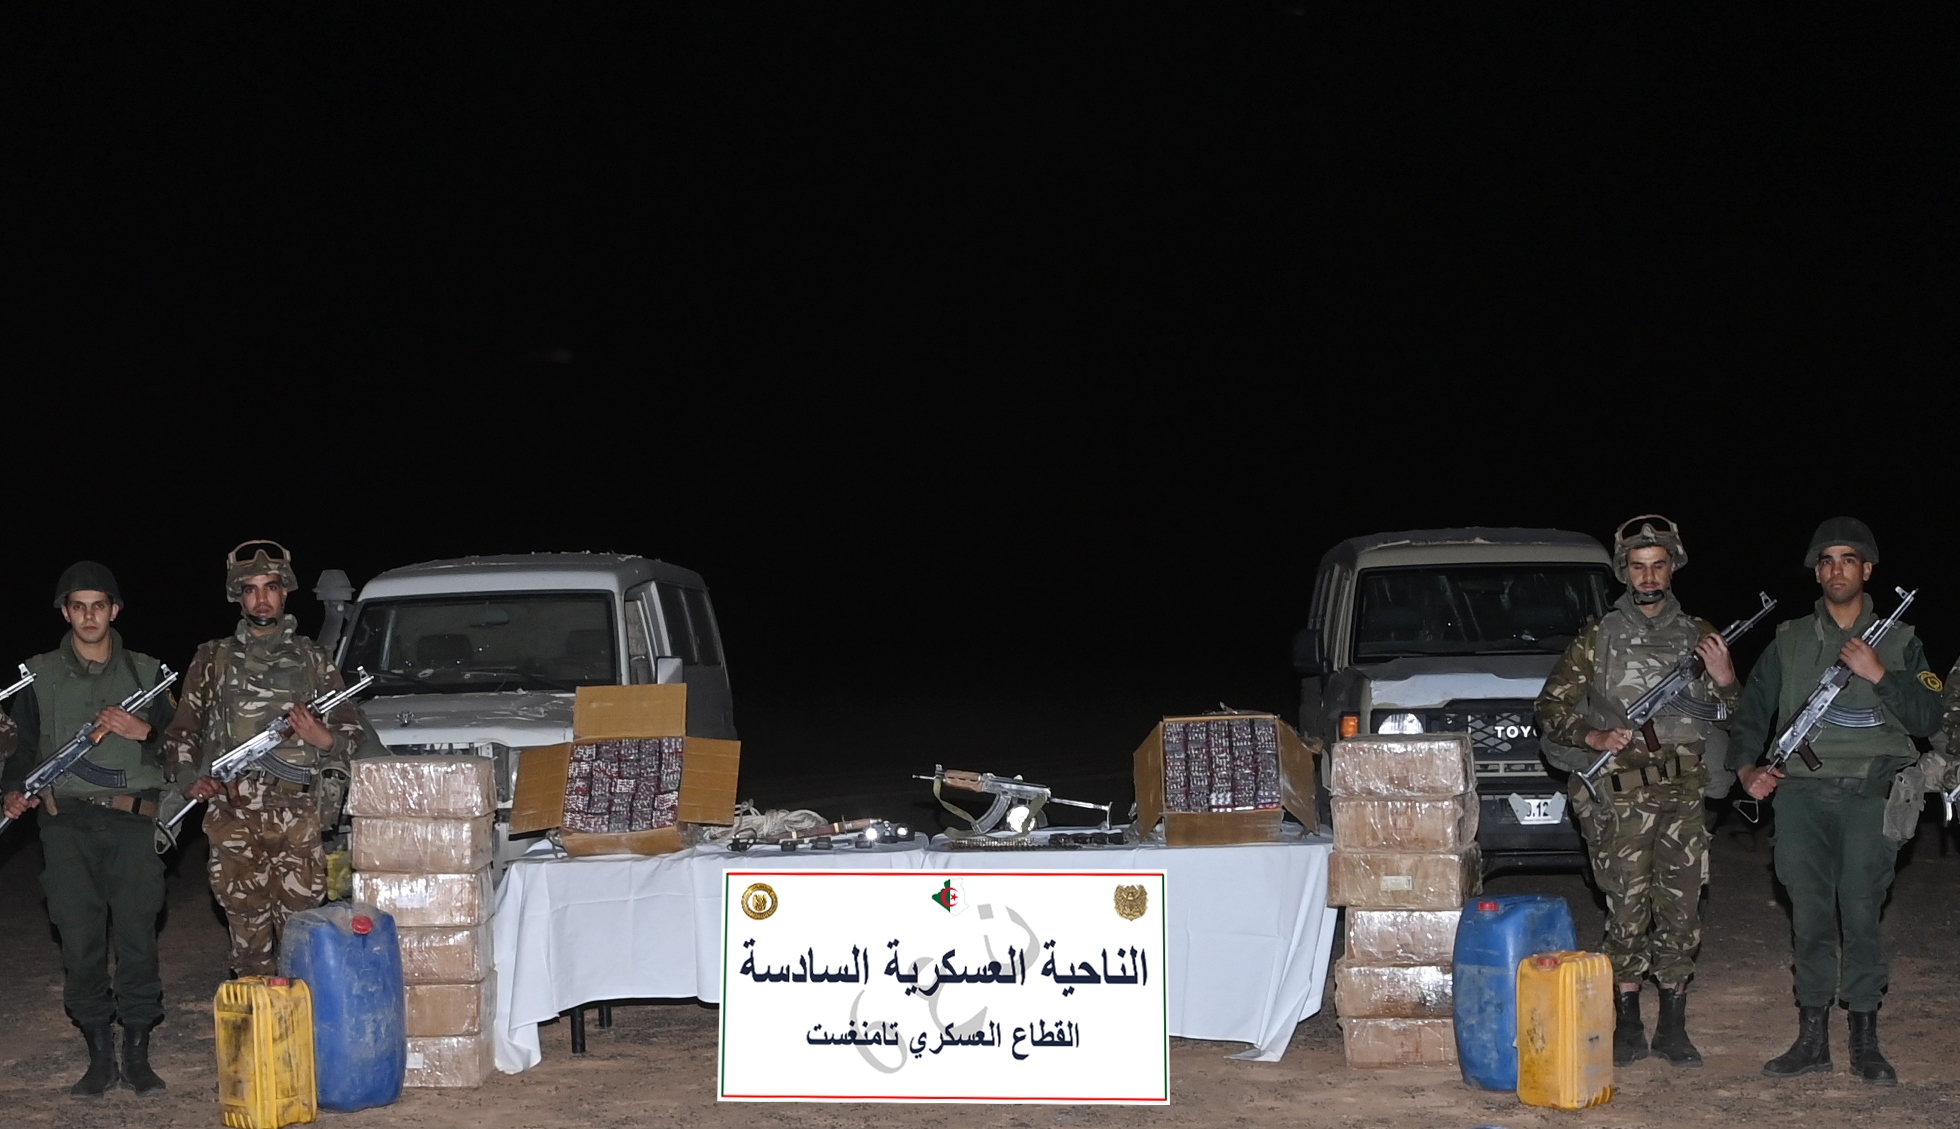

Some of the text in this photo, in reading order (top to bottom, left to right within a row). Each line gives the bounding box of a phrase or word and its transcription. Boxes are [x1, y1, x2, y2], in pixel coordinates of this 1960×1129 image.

[1494, 725, 1538, 739] TOY
[739, 938, 1148, 997] الناحية العسكرية السادسة
[806, 1019, 1080, 1061] القطاع العسكري تامنغست
